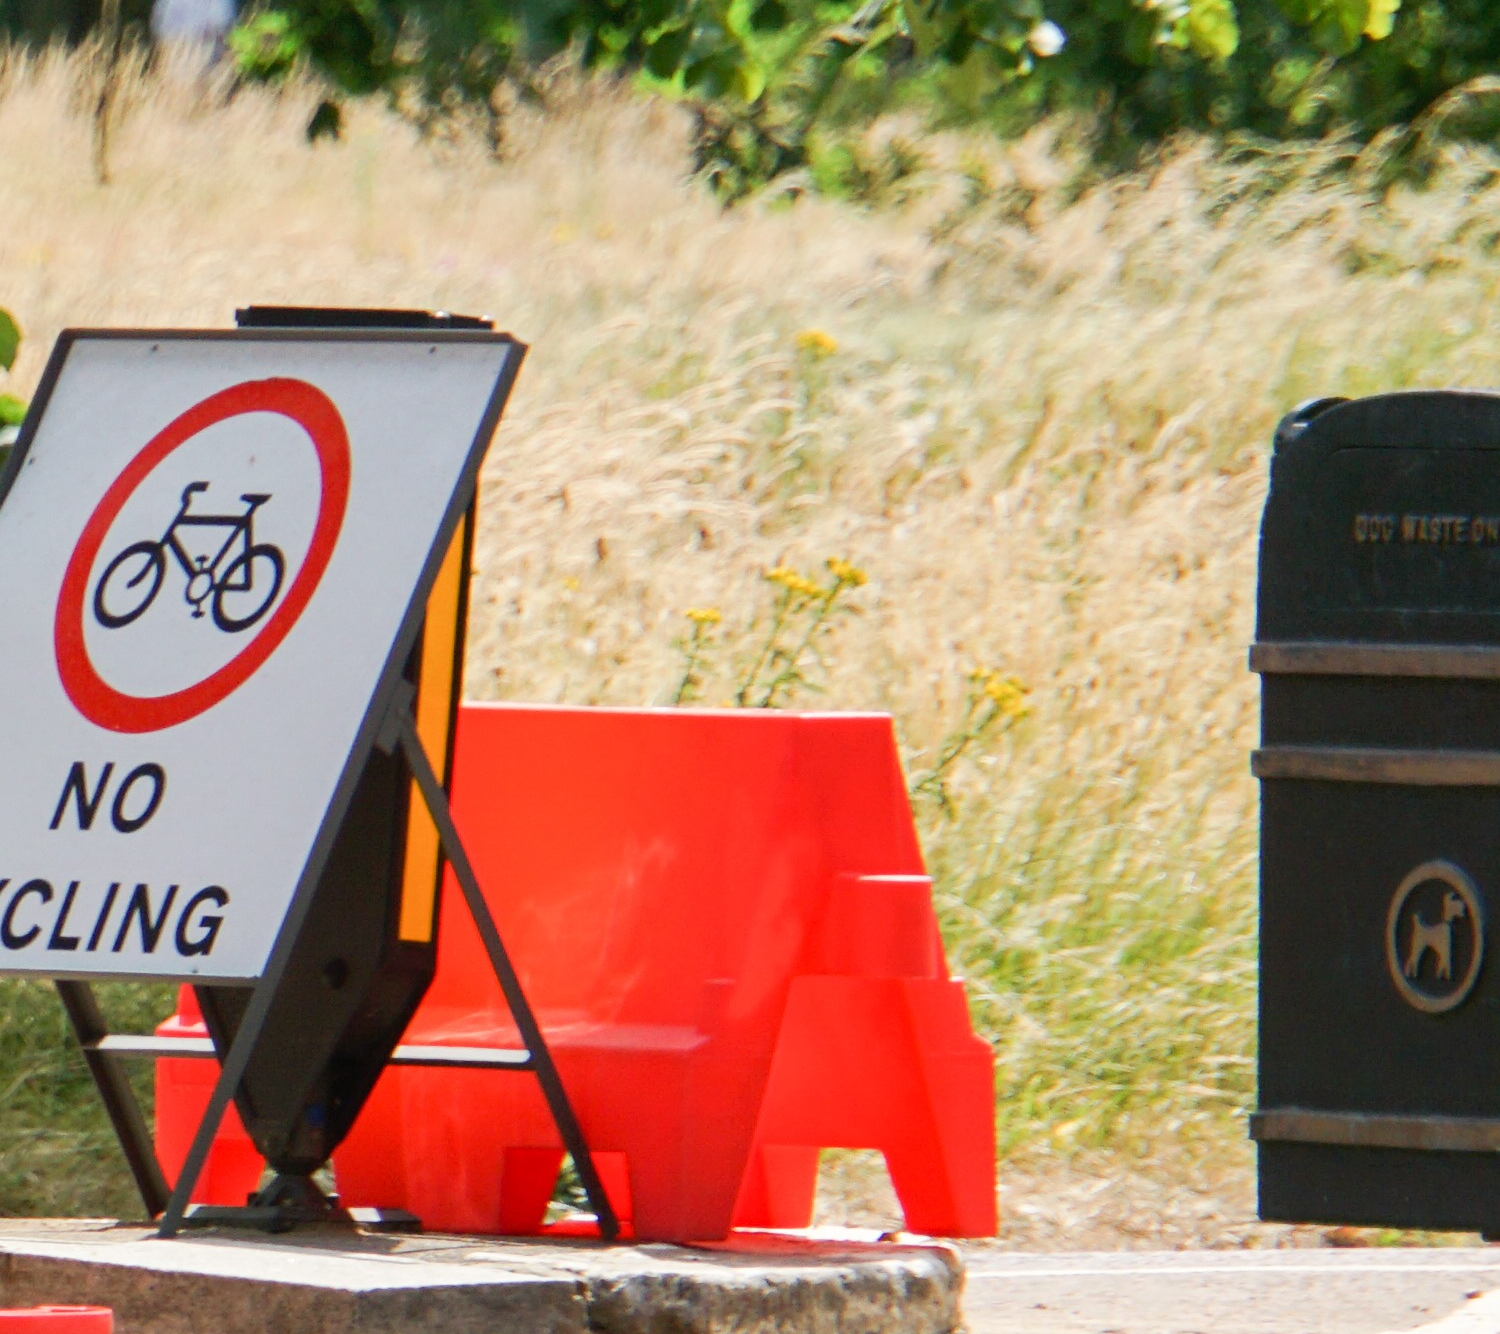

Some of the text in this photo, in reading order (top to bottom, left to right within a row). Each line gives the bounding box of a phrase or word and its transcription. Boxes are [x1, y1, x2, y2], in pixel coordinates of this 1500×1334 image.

[1353, 515, 1393, 543] DOG
[1401, 515, 1468, 544] WASTE
[49, 761, 168, 834] NO
